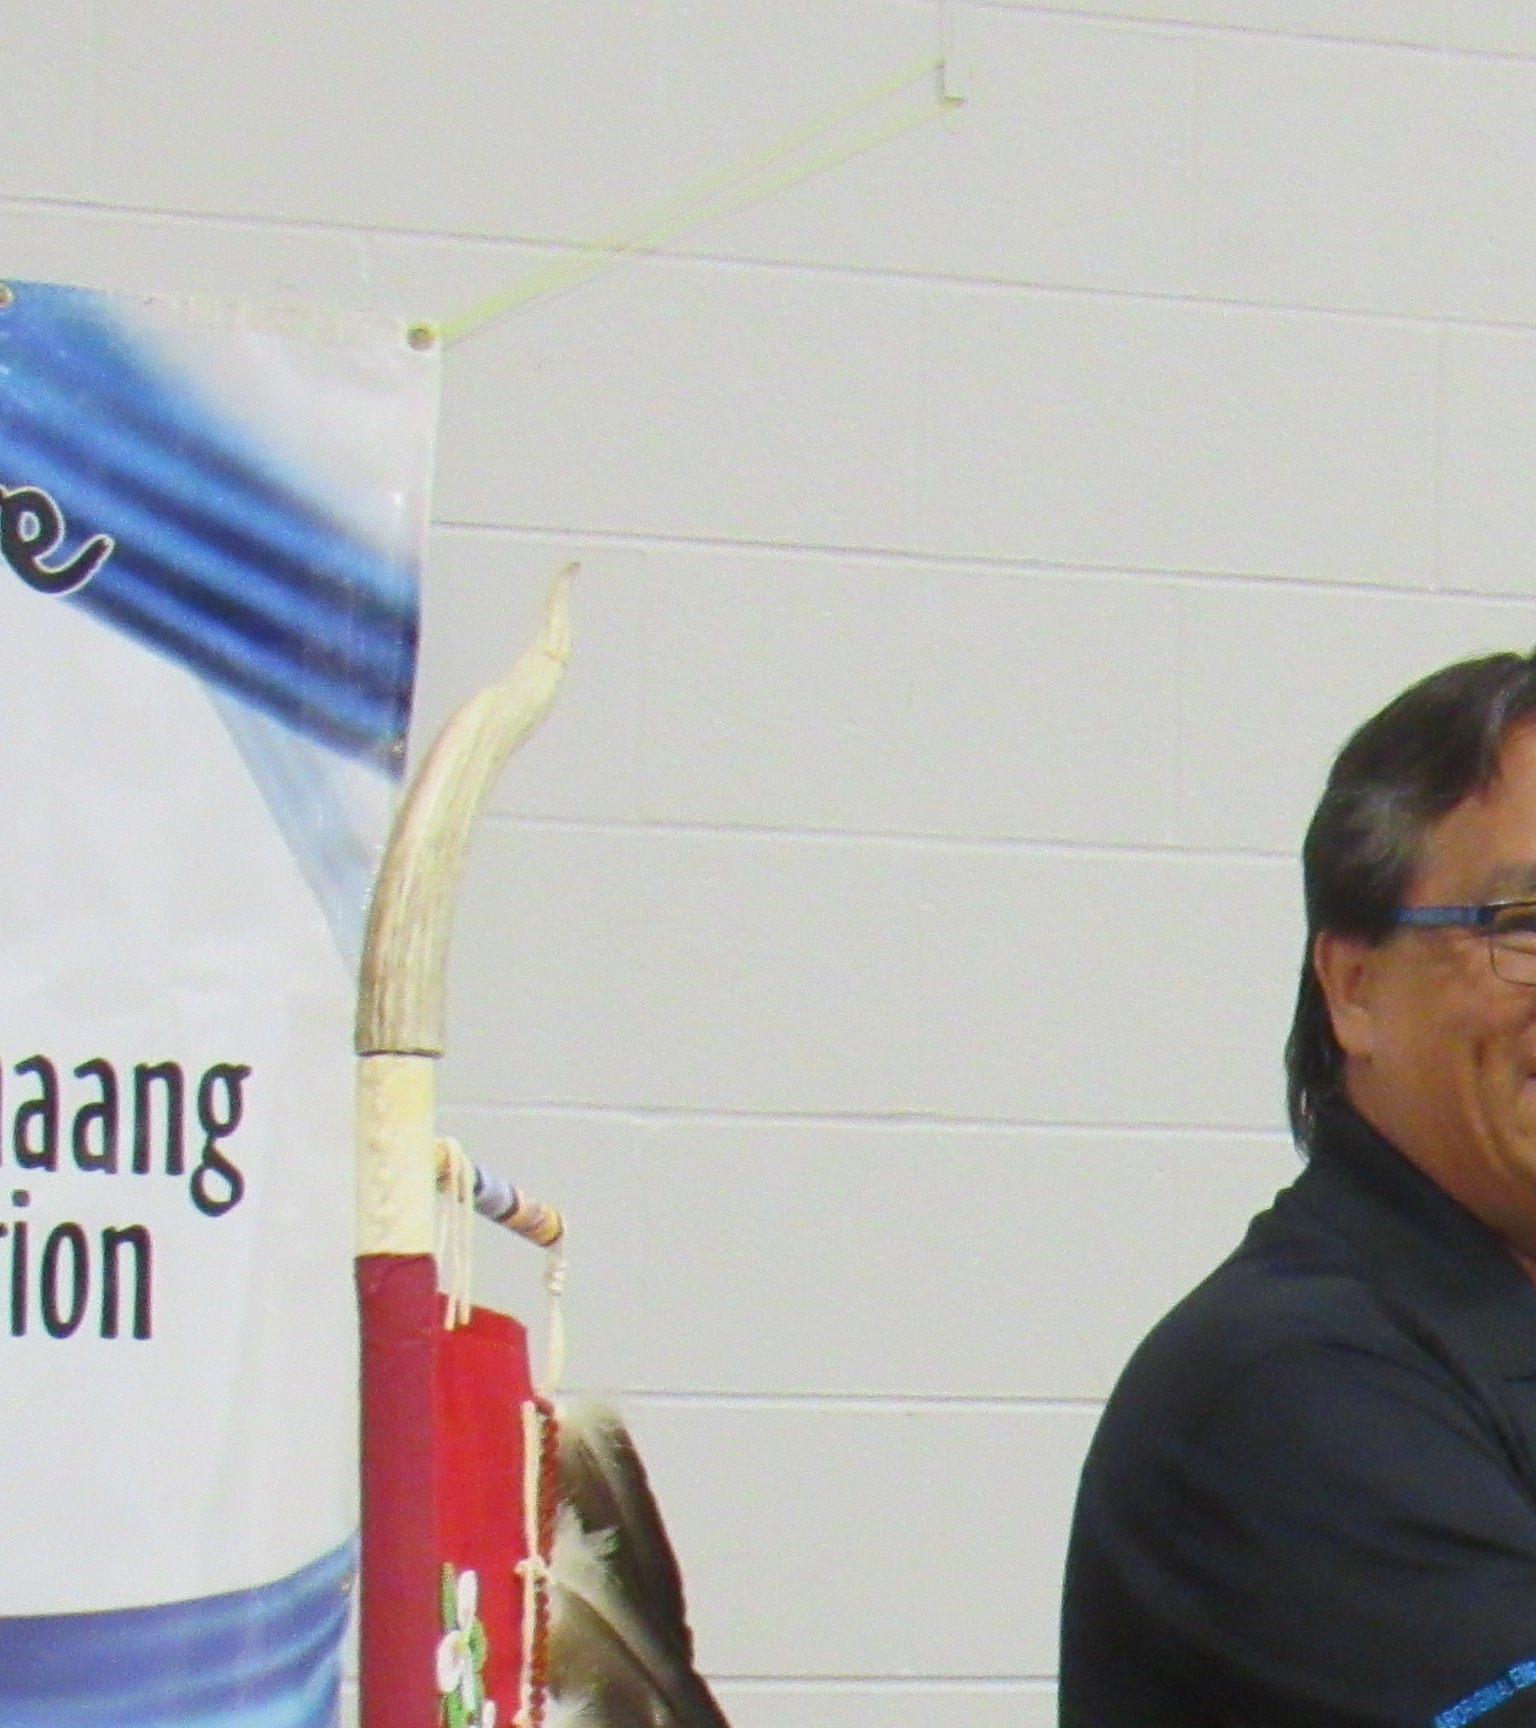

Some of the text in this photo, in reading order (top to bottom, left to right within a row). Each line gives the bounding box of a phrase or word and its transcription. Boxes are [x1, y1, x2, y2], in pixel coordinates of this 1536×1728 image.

[0, 484, 115, 596] e
[0, 1053, 253, 1218] aang
[0, 1188, 154, 1341] ion
